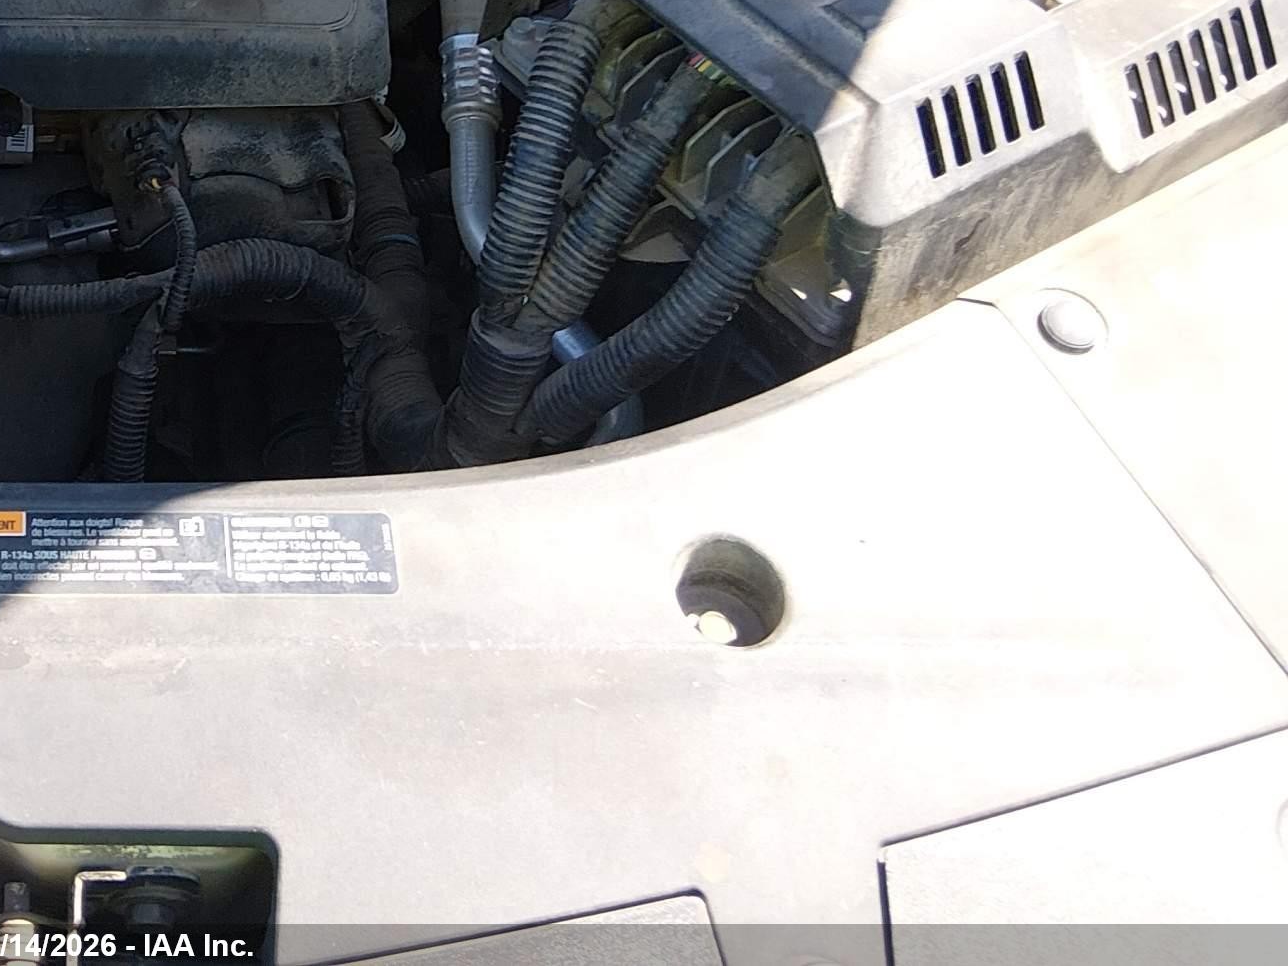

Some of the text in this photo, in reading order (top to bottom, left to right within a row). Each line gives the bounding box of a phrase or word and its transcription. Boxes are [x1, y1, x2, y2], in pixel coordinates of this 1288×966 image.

[32, 518, 68, 527] Attention
[32, 528, 43, 536] de
[86, 528, 97, 536] Le
[1, 550, 33, 560] R-134a
[34, 550, 58, 560] SOUS
[59, 550, 90, 560] HAUTE
